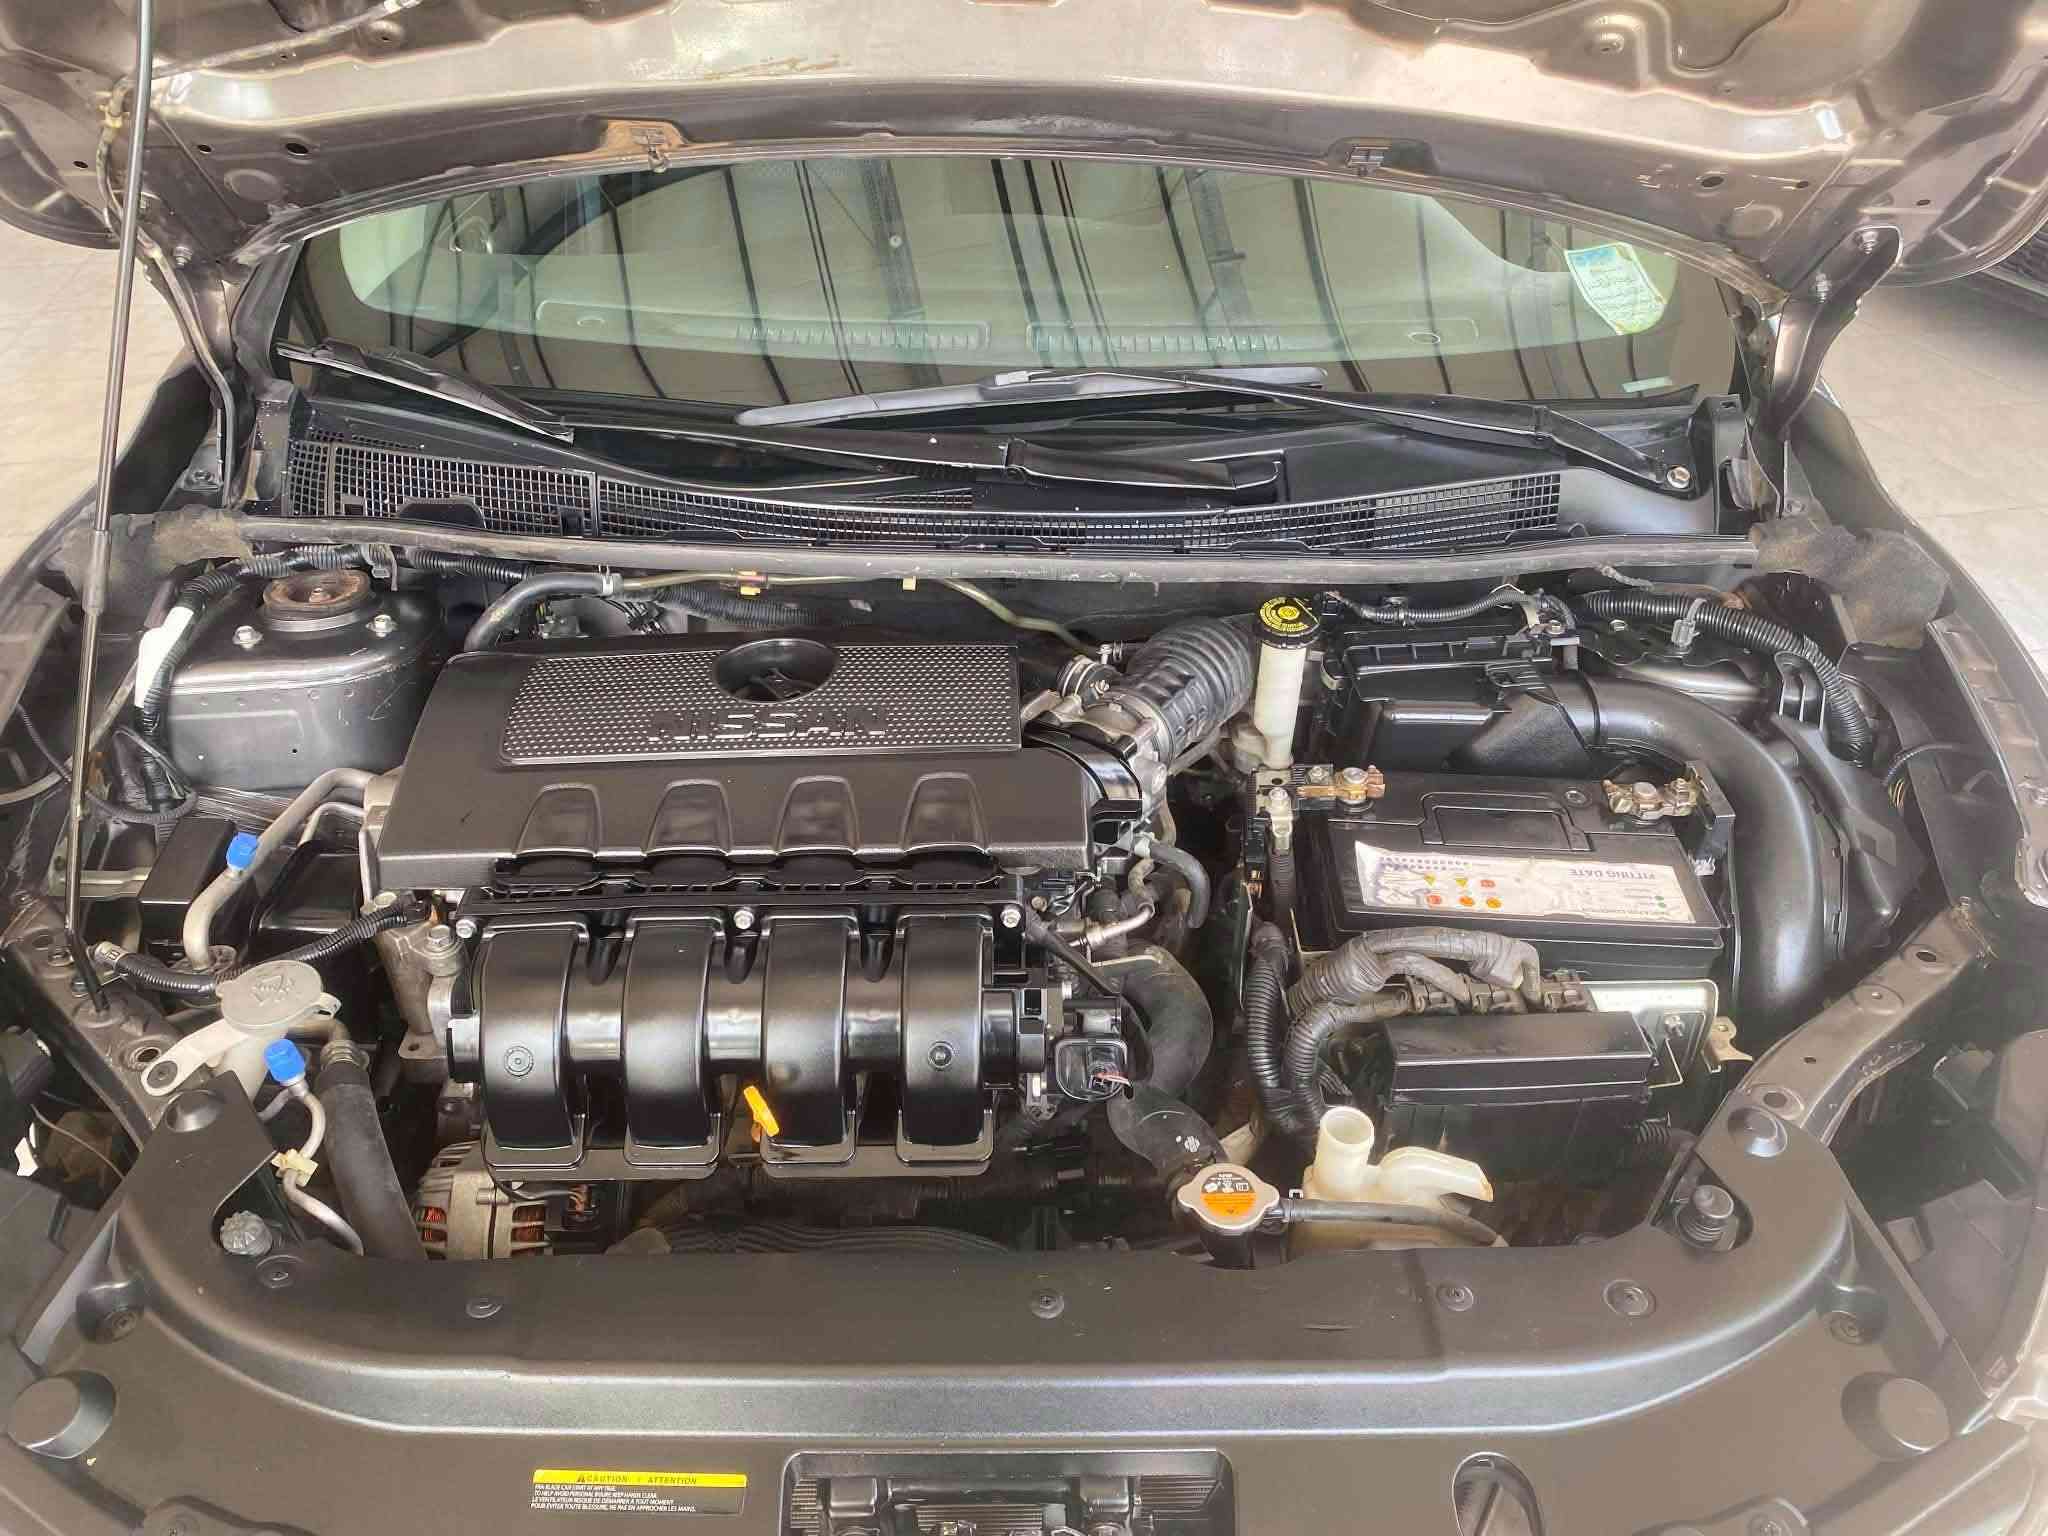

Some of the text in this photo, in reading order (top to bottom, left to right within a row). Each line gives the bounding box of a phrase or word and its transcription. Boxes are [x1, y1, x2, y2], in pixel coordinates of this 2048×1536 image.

[648, 708, 889, 741] NISSAN
[1567, 868, 1603, 879] DATE
[585, 1475, 697, 1486] CAUTION ATTENTION
[668, 1505, 677, 1513] LES
